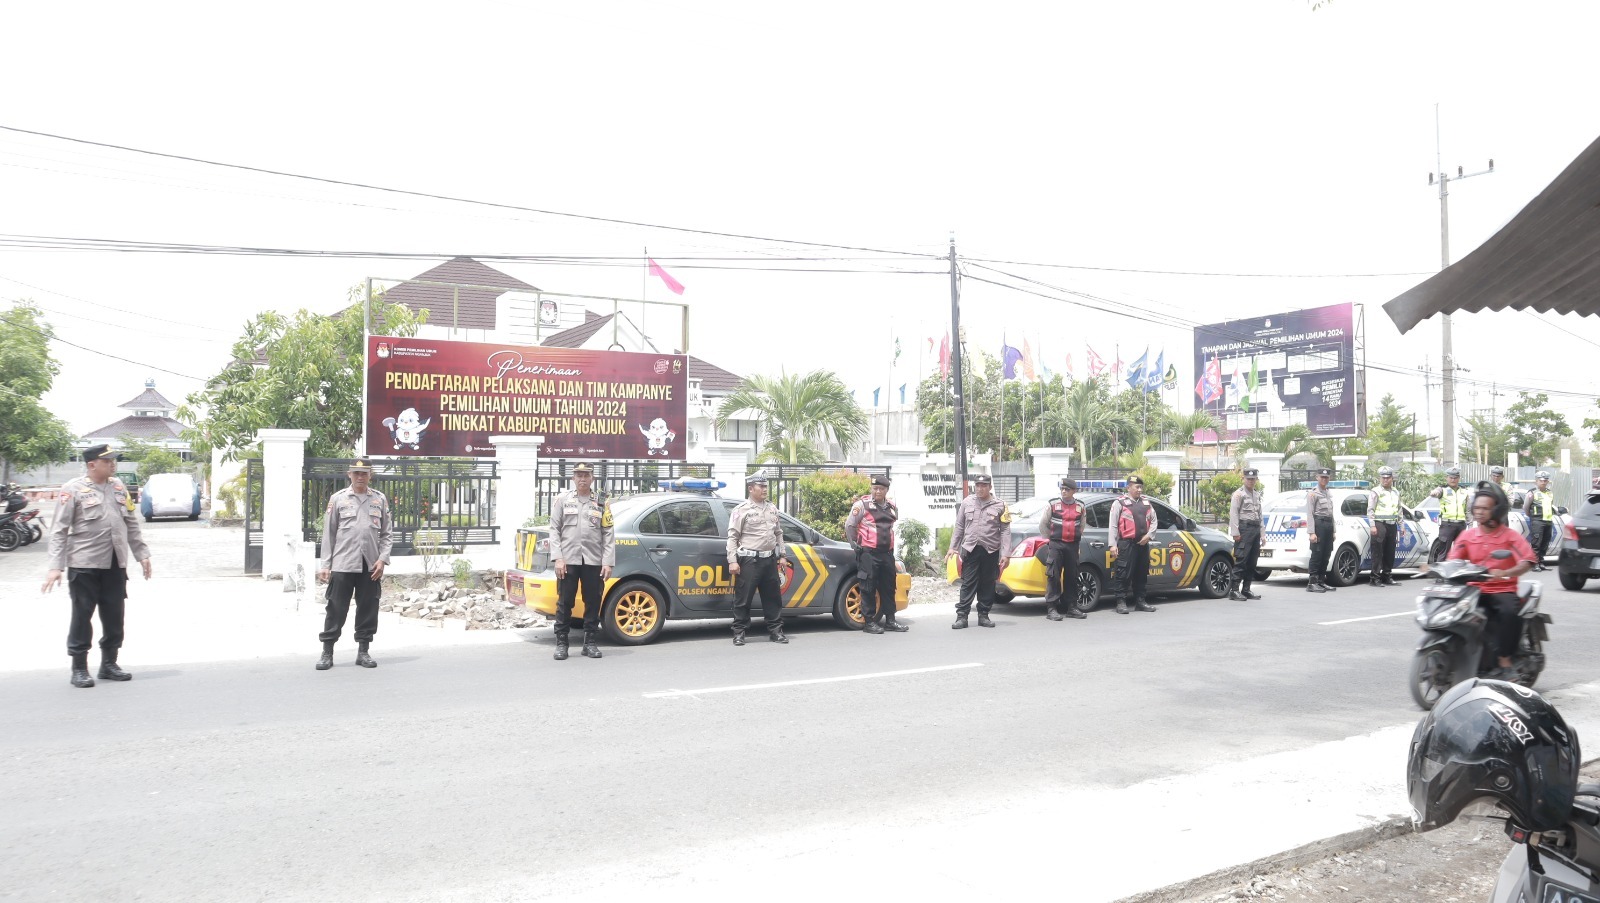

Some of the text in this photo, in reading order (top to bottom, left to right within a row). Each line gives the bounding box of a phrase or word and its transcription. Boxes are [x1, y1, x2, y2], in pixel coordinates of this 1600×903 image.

[1201, 344, 1228, 353] TAHAPAN
[1228, 341, 1242, 350] DAN
[1269, 333, 1304, 345] PEMILIHAN
[1305, 331, 1326, 340] UMUM
[1327, 328, 1344, 337] 2024
[487, 350, 582, 379] Penerimaan
[385, 371, 673, 401] PENDAFTARAN PELAKSANA DAN TIM KAMPANYE
[440, 394, 627, 417] PEMILIHAN UMUM TAHUN 2024
[440, 413, 626, 435] TINGKAT KABUPATEN NGANJUK
[677, 588, 706, 596] POLSEK
